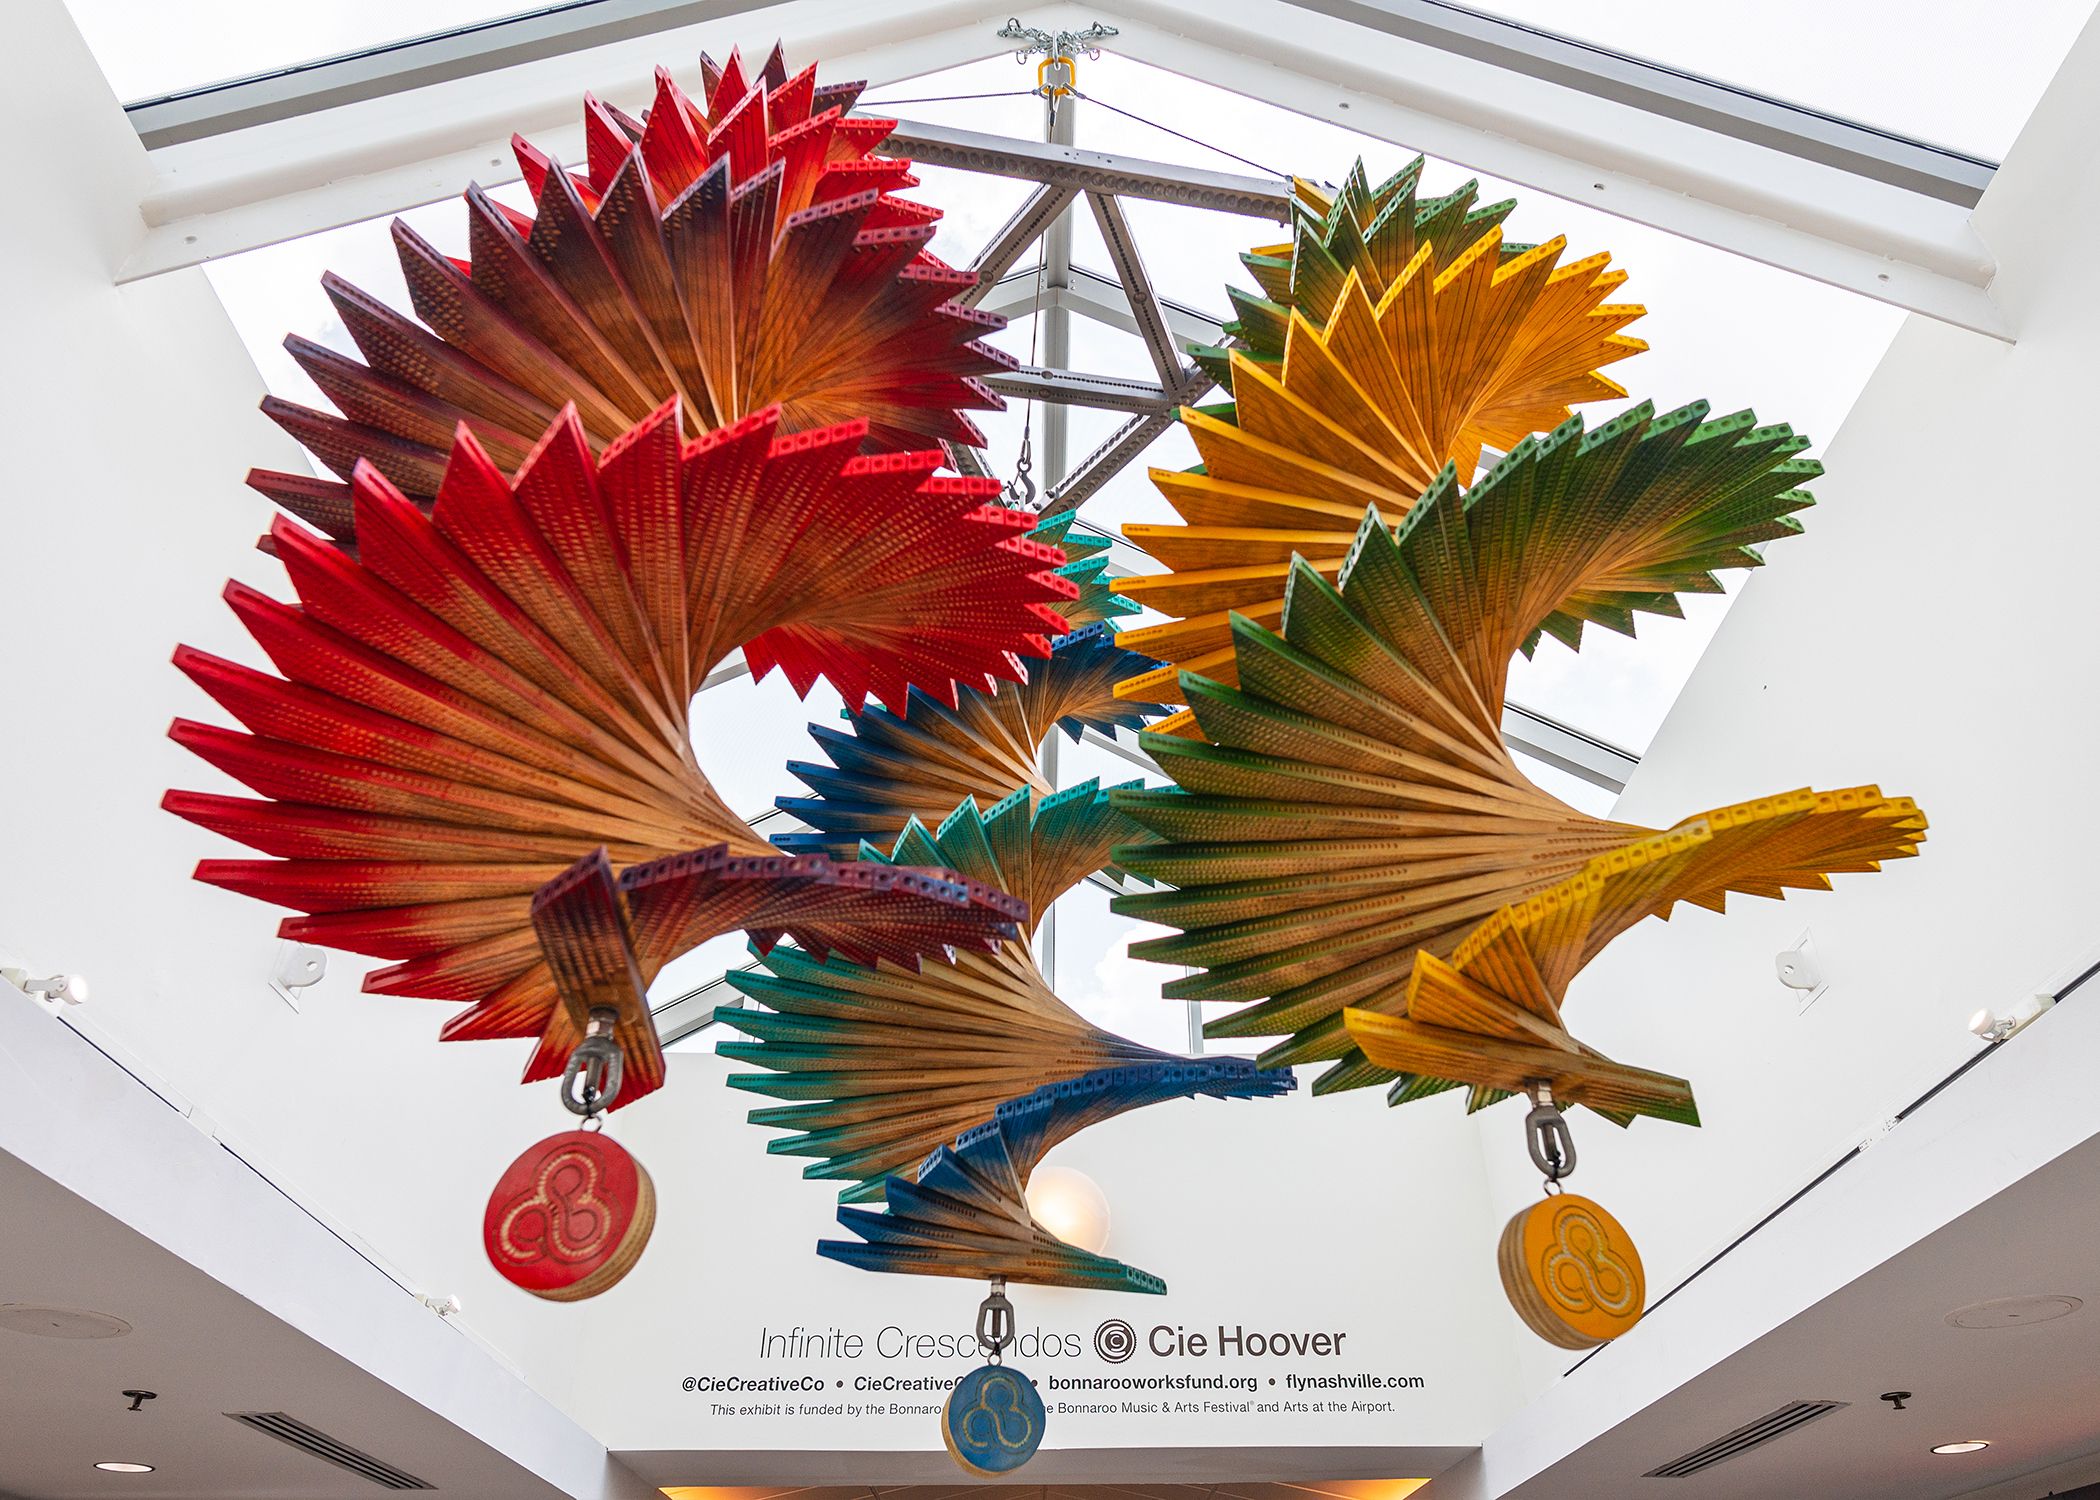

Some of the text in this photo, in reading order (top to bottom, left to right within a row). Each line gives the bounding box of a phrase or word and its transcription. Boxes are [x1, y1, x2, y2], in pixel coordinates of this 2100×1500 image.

[760, 1325, 863, 1359] Infinite
[1149, 1324, 1207, 1357] Cie
[1218, 1325, 1346, 1357] Hoover
[682, 1373, 1424, 1393] @CieCreativeCo CieCreative bonnarooworksfund.org flynashville.com
[711, 1402, 736, 1416] This
[740, 1401, 781, 1416] exhibit
[785, 1402, 795, 1416] is
[799, 1402, 843, 1416] funded
[847, 1402, 863, 1418] by
[866, 1402, 885, 1415] the
[889, 1402, 942, 1415] Bonnaro
[1058, 1401, 1117, 1414] Bonnaroo
[1122, 1401, 1157, 1414] Music
[1161, 1401, 1171, 1414] &
[1174, 1401, 1200, 1414] Arts
[1257, 1400, 1280, 1413] and
[1284, 1400, 1308, 1413] Arts
[1312, 1400, 1324, 1413] at
[1328, 1400, 1347, 1413] the
[1351, 1399, 1395, 1415] Airport.
